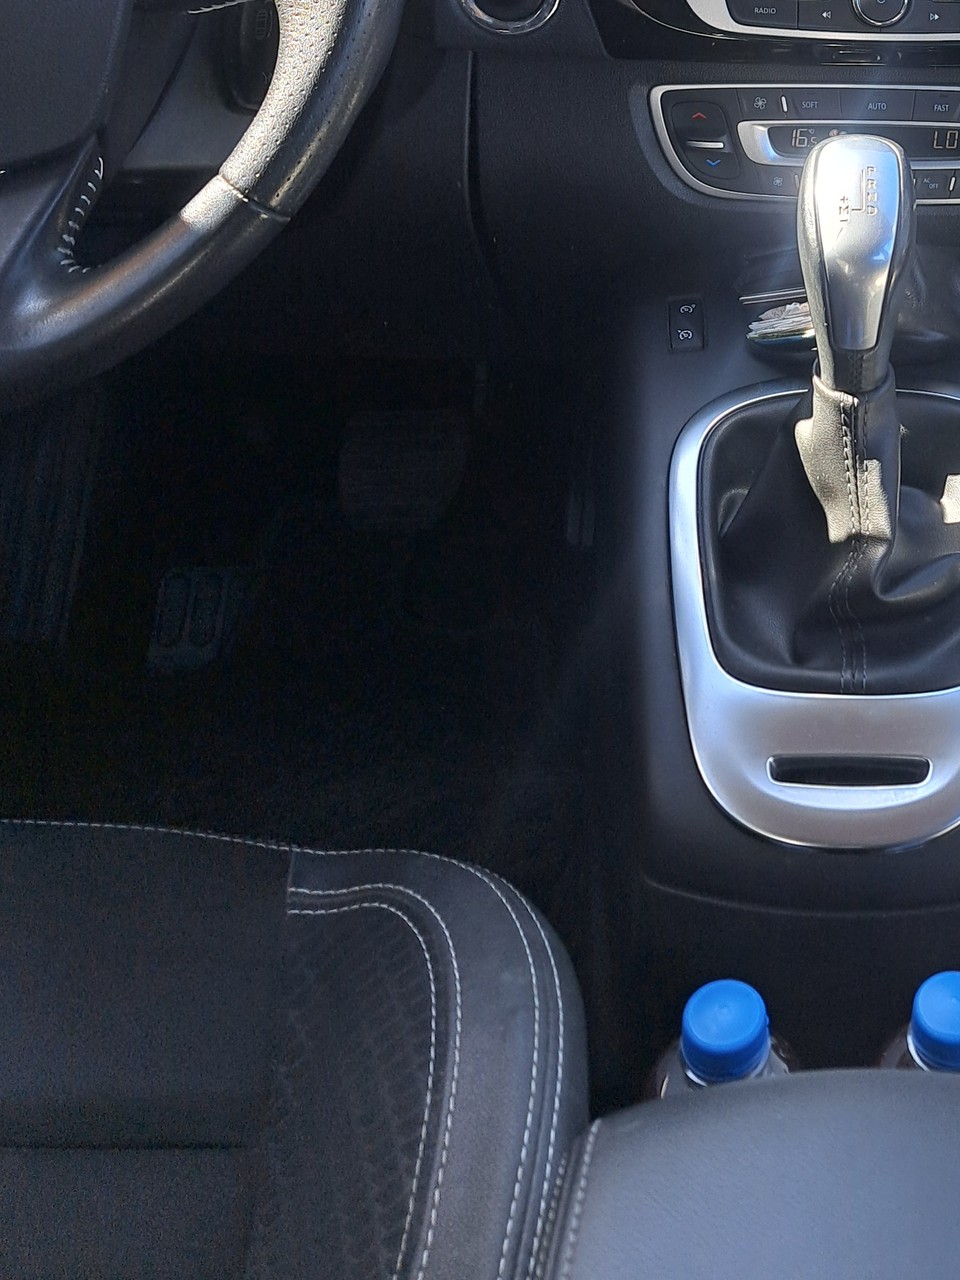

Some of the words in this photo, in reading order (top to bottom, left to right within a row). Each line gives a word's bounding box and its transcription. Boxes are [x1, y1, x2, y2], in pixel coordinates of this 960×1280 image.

[754, 7, 777, 15] RADIO
[802, 101, 818, 109] SOFT
[867, 102, 887, 110] AUTO
[934, 104, 950, 112] FAST
[866, 205, 878, 216] D
